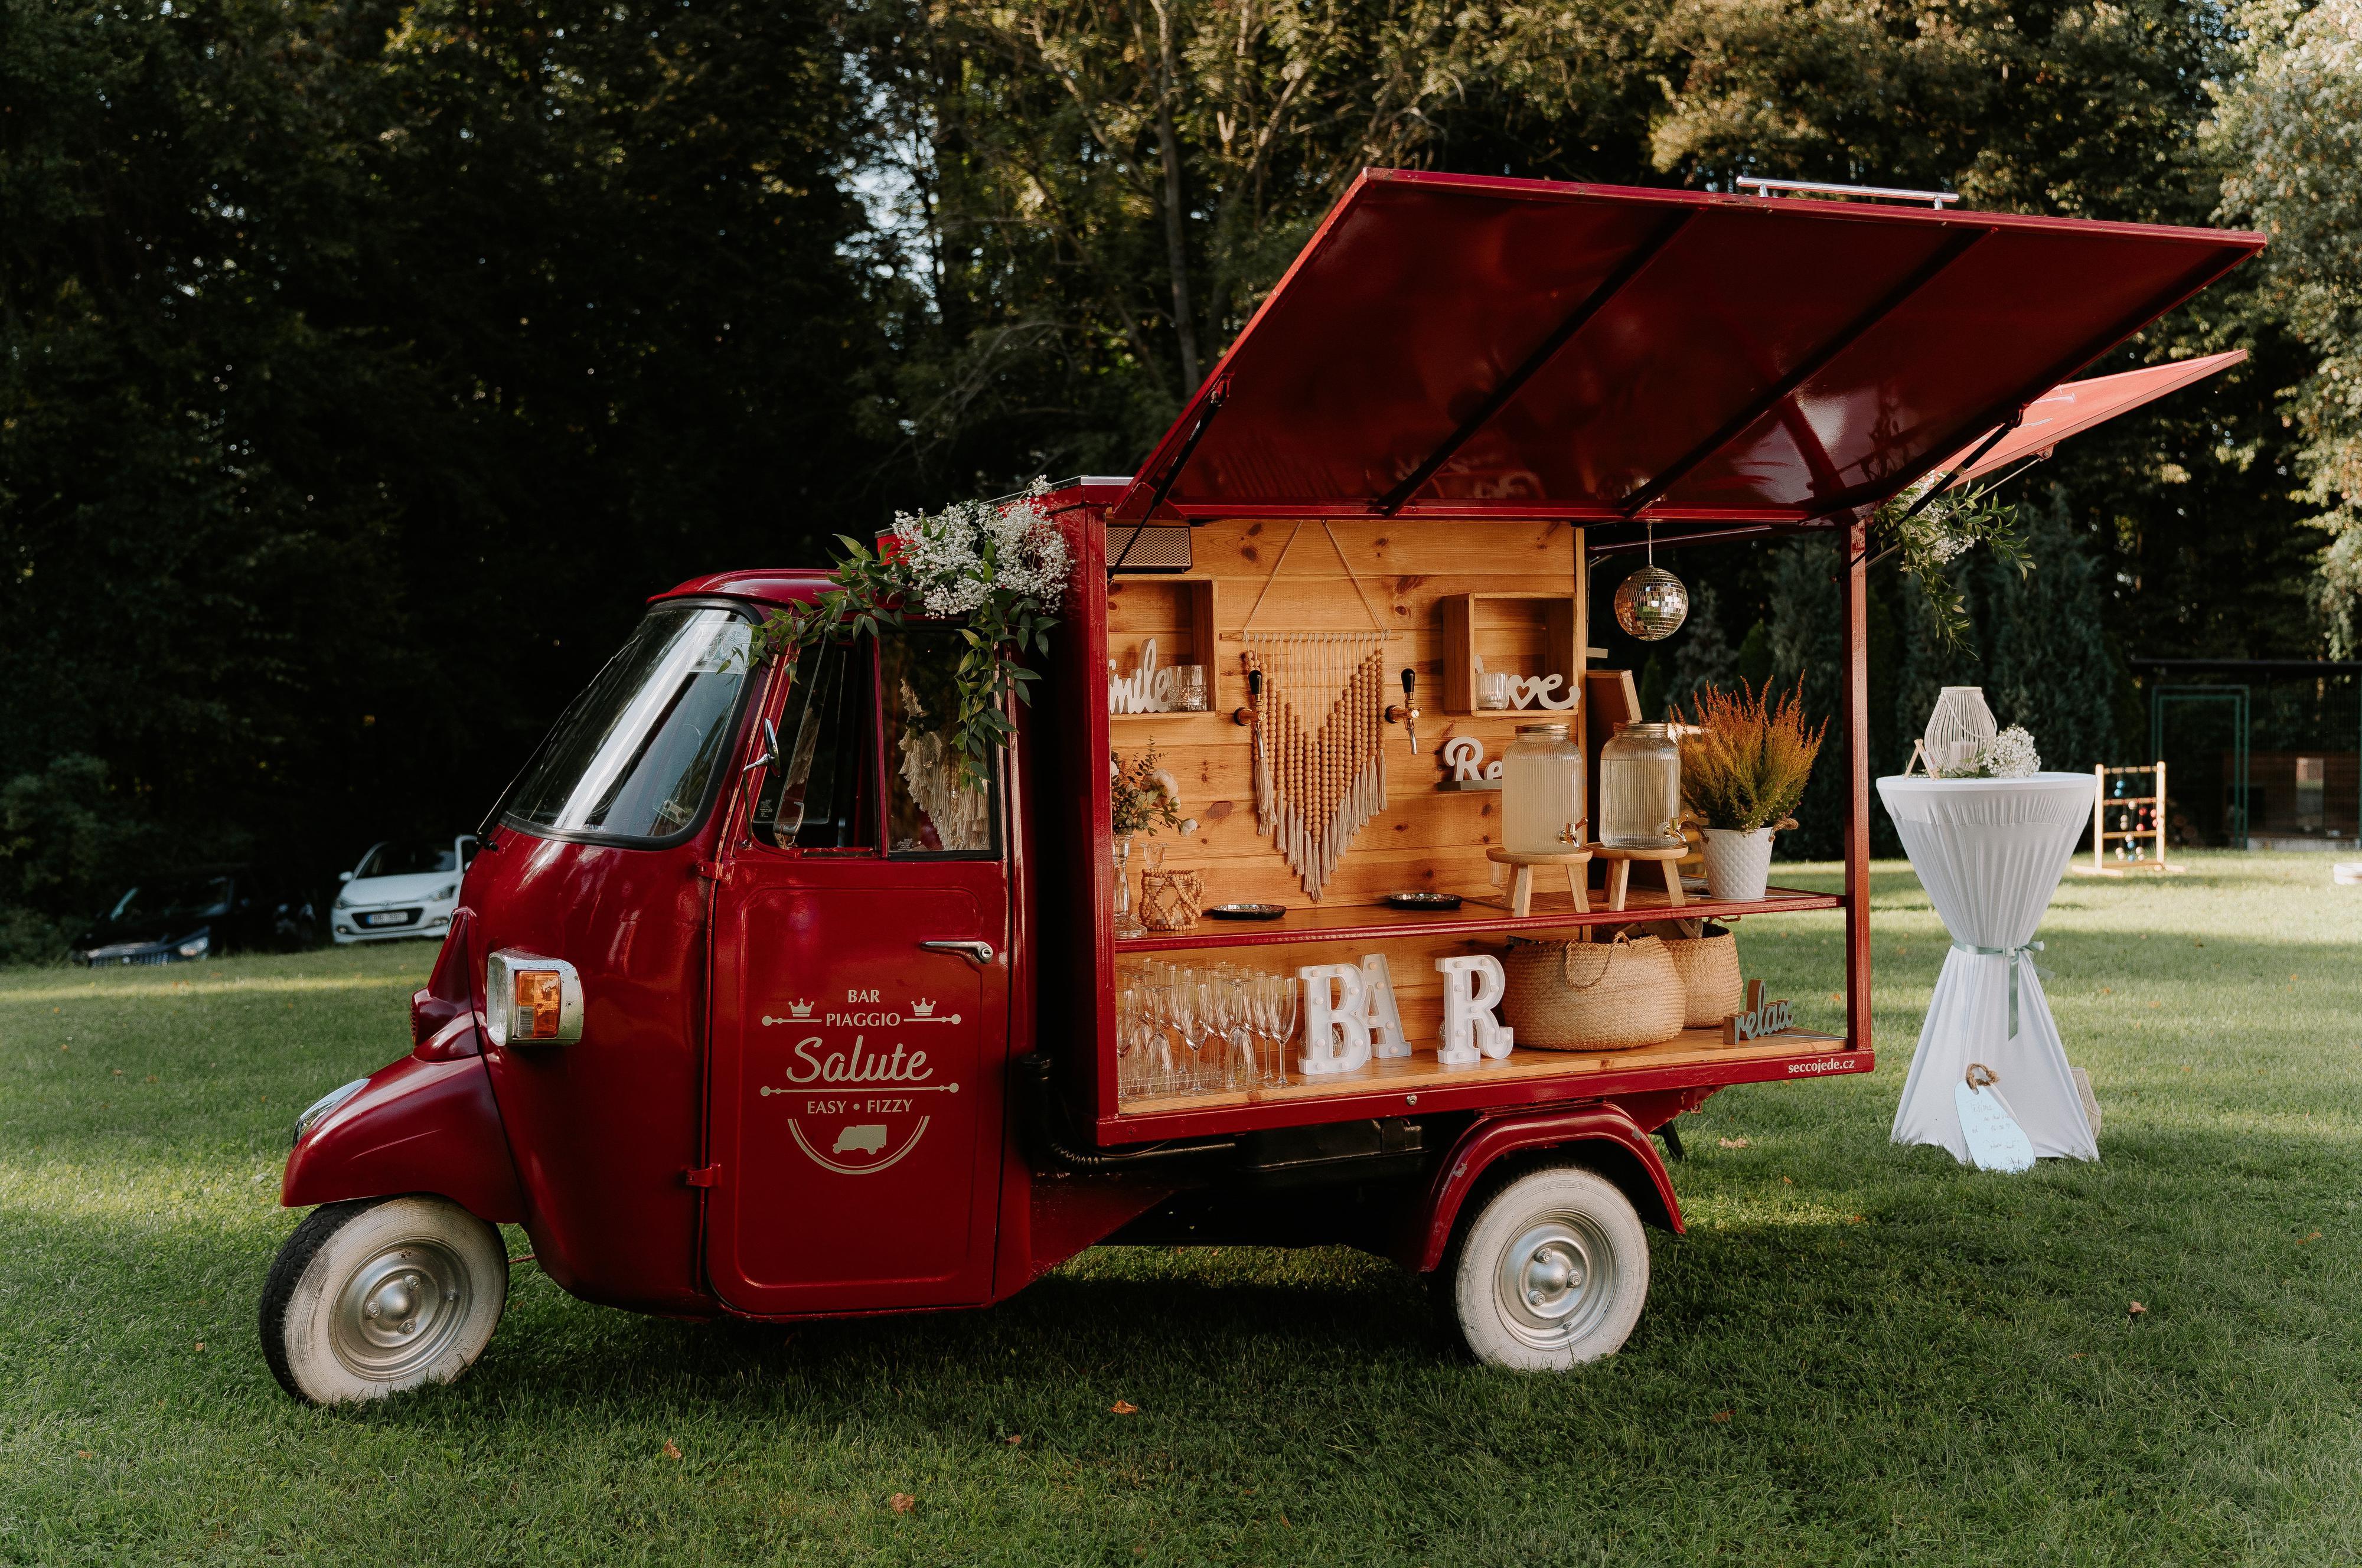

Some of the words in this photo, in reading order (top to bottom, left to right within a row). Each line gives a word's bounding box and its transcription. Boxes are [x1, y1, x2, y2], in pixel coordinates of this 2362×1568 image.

[1110, 638, 1168, 713] mile
[1444, 736, 1503, 781] Re
[848, 989, 880, 1003] BAR
[1296, 953, 1513, 1075] BAR
[1730, 979, 1793, 1045] relax
[826, 1012, 901, 1027] PIAGGIO
[786, 1035, 934, 1083] Salute
[1788, 1059, 1855, 1074] seccojede.cz
[807, 1100, 847, 1114] EASY
[867, 1099, 913, 1113] FIZZY
